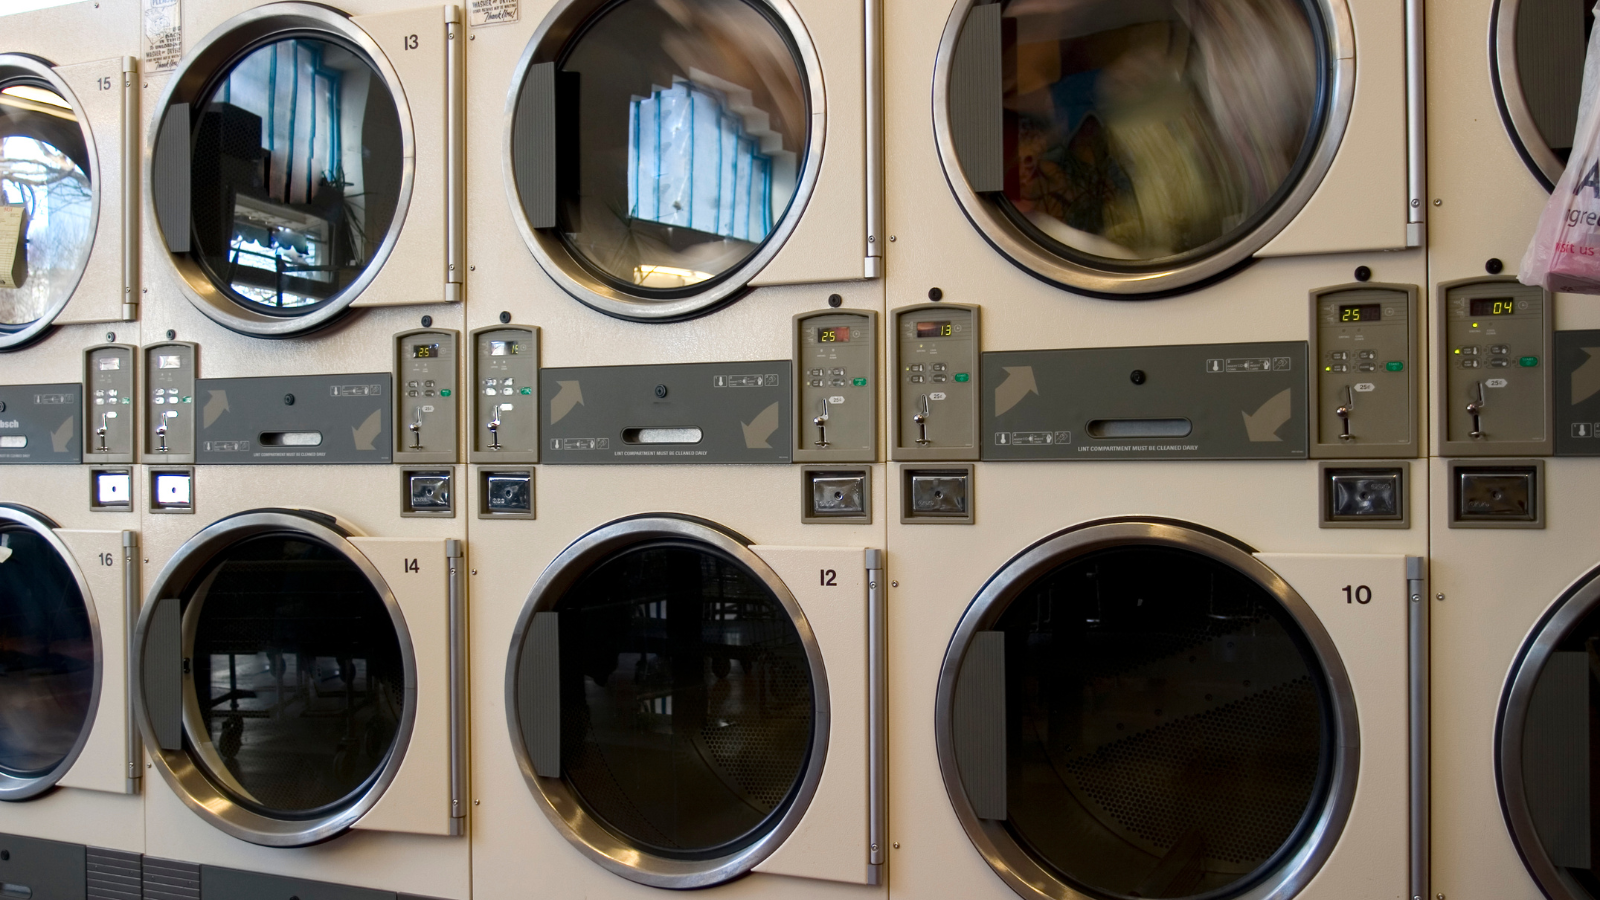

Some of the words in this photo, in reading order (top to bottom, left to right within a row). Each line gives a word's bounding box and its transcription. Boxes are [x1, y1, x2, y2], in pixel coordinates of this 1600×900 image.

[404, 34, 419, 51] 13
[97, 76, 111, 91] 15
[1579, 246, 1595, 257] us
[1342, 308, 1360, 322] 25
[1493, 301, 1513, 315] 04
[821, 331, 836, 342] 25
[940, 324, 952, 336] 13
[418, 347, 430, 358] 25
[98, 552, 113, 567] 16
[404, 557, 420, 574] 14
[820, 568, 838, 587] 12
[1341, 584, 1373, 605] 10
